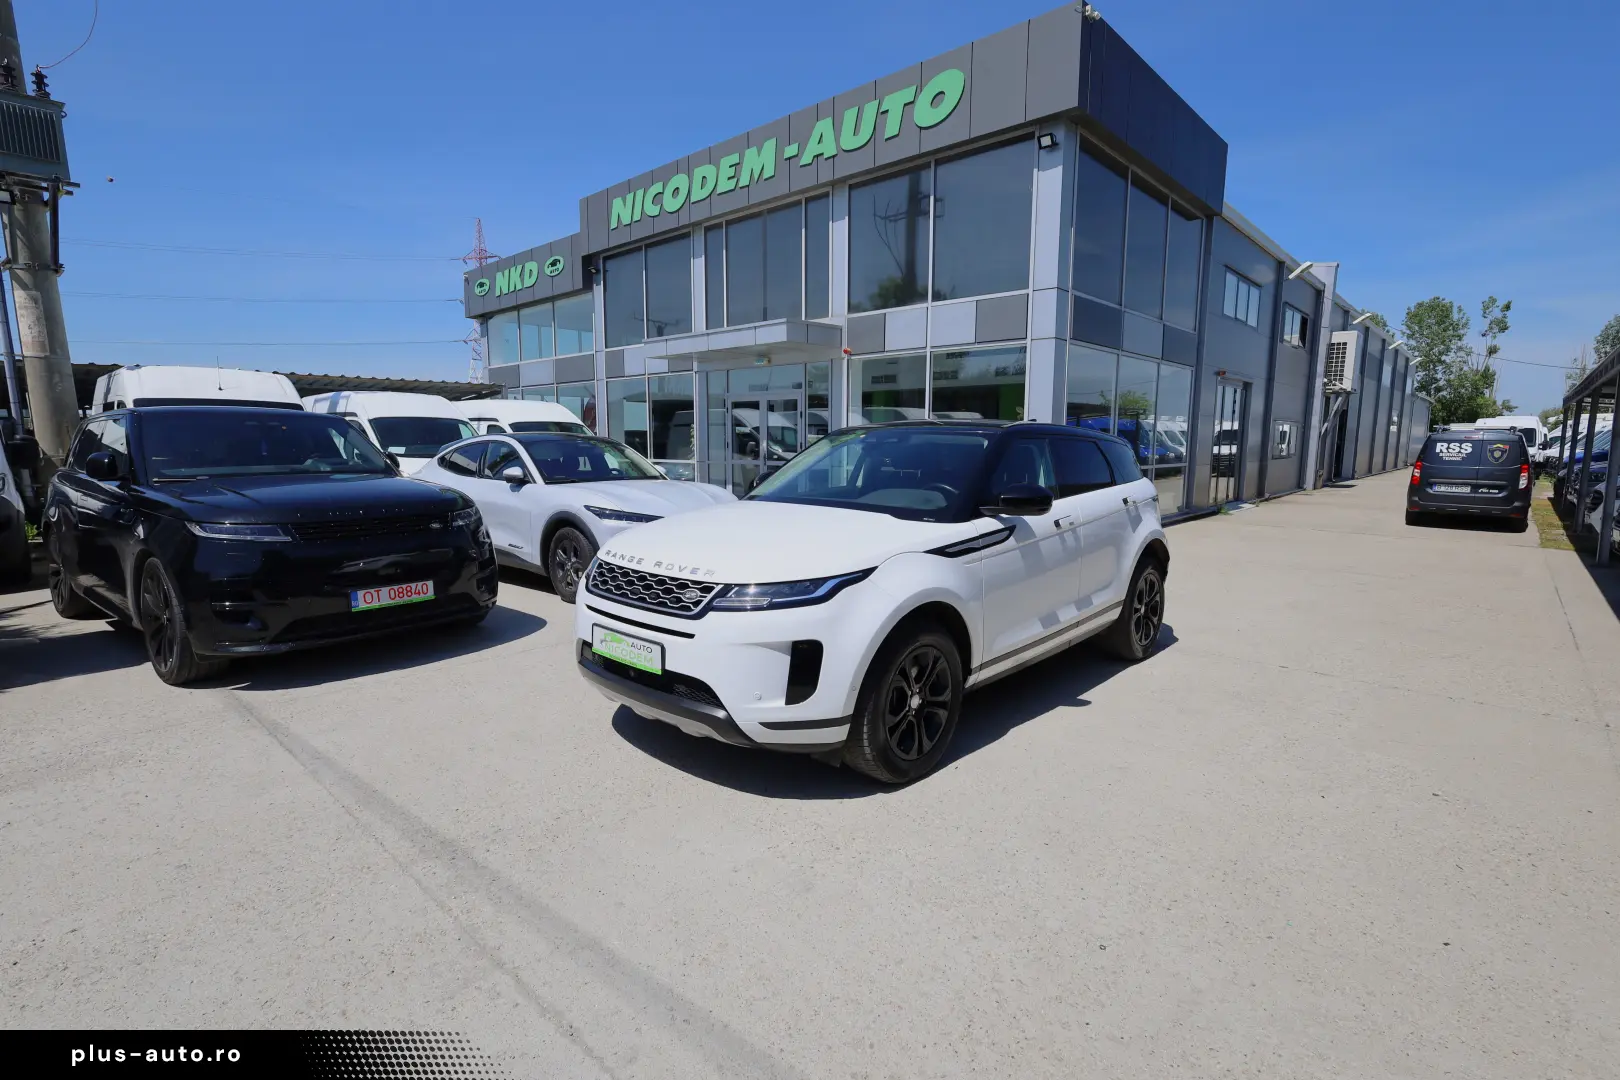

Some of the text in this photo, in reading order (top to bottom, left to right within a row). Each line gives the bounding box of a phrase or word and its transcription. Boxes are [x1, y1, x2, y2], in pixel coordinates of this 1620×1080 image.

[496, 261, 539, 297] NKD
[1435, 442, 1473, 453] RSS
[604, 549, 716, 577] RANGE ROVER
[363, 589, 382, 604] OT
[388, 582, 429, 600] 08840
[630, 641, 653, 654] AUTO
